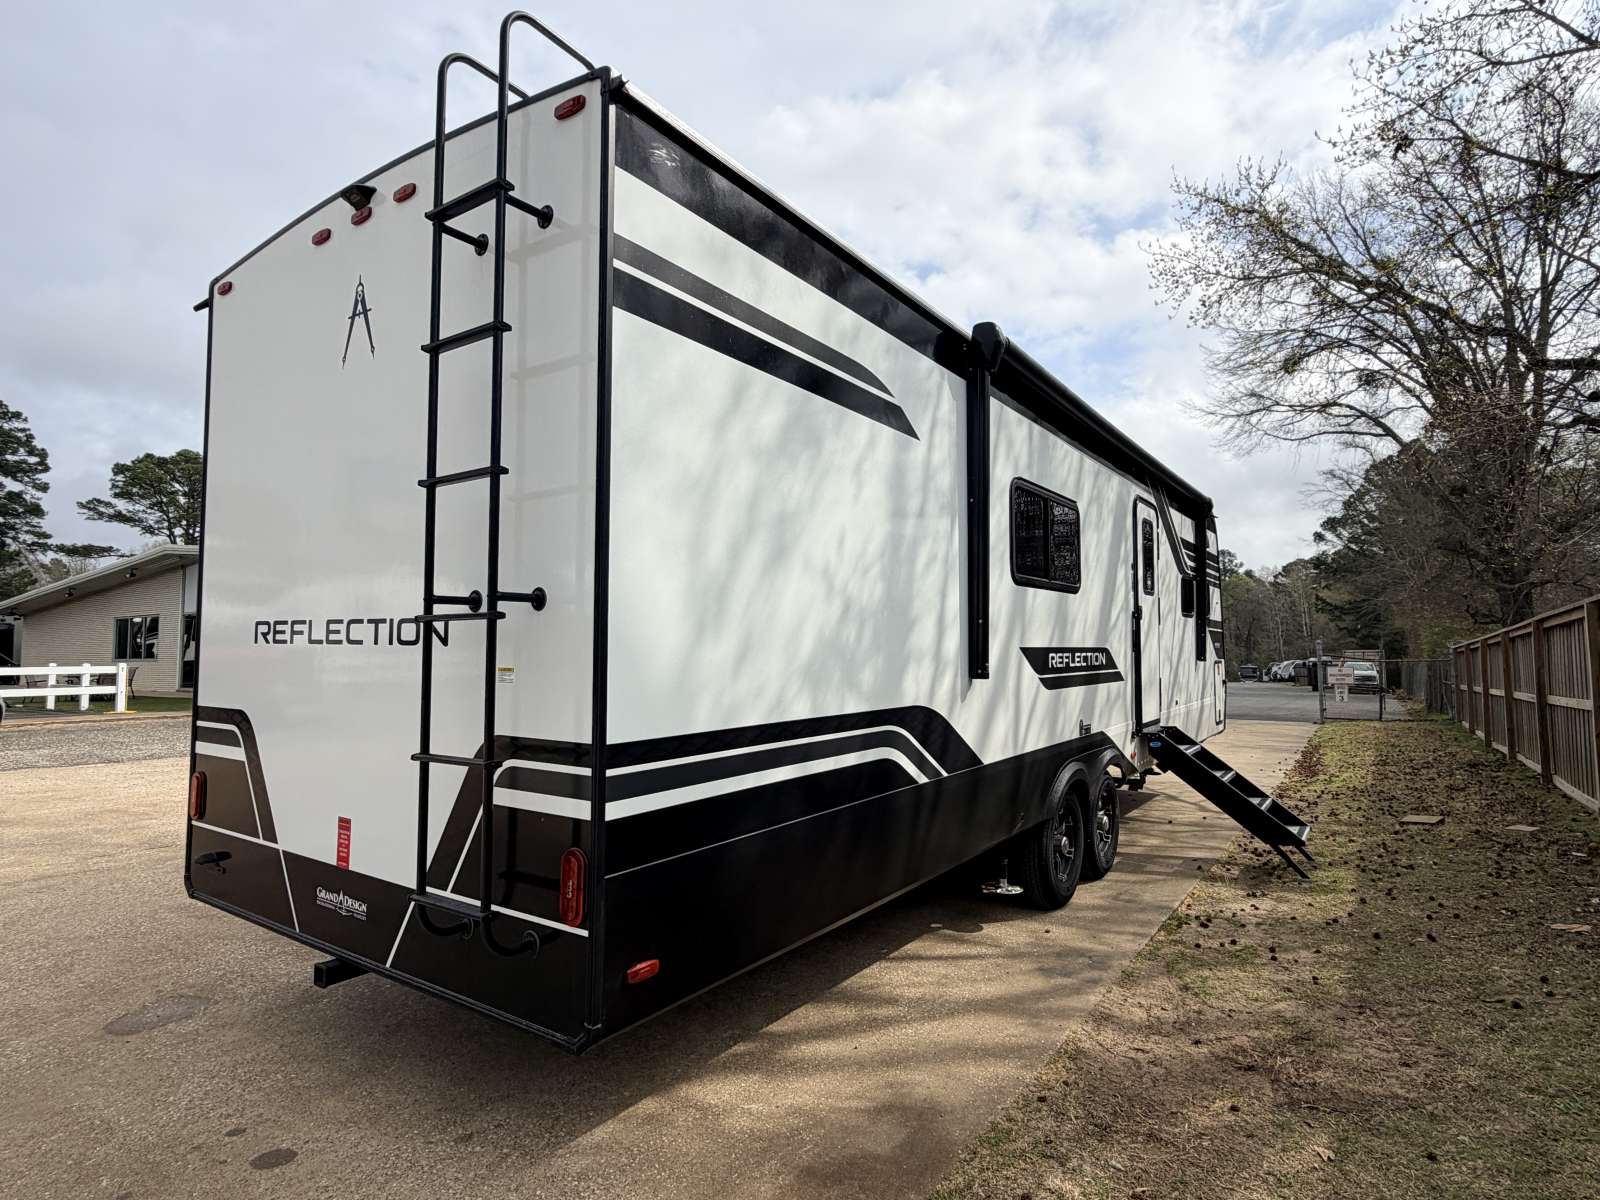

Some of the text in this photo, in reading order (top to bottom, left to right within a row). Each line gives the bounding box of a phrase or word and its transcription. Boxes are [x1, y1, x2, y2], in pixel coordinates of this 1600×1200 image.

[254, 618, 449, 647] REFLECTION
[1048, 652, 1106, 668] REFLECTION
[316, 886, 338, 902] GRAND
[344, 895, 367, 912] DESIGN
